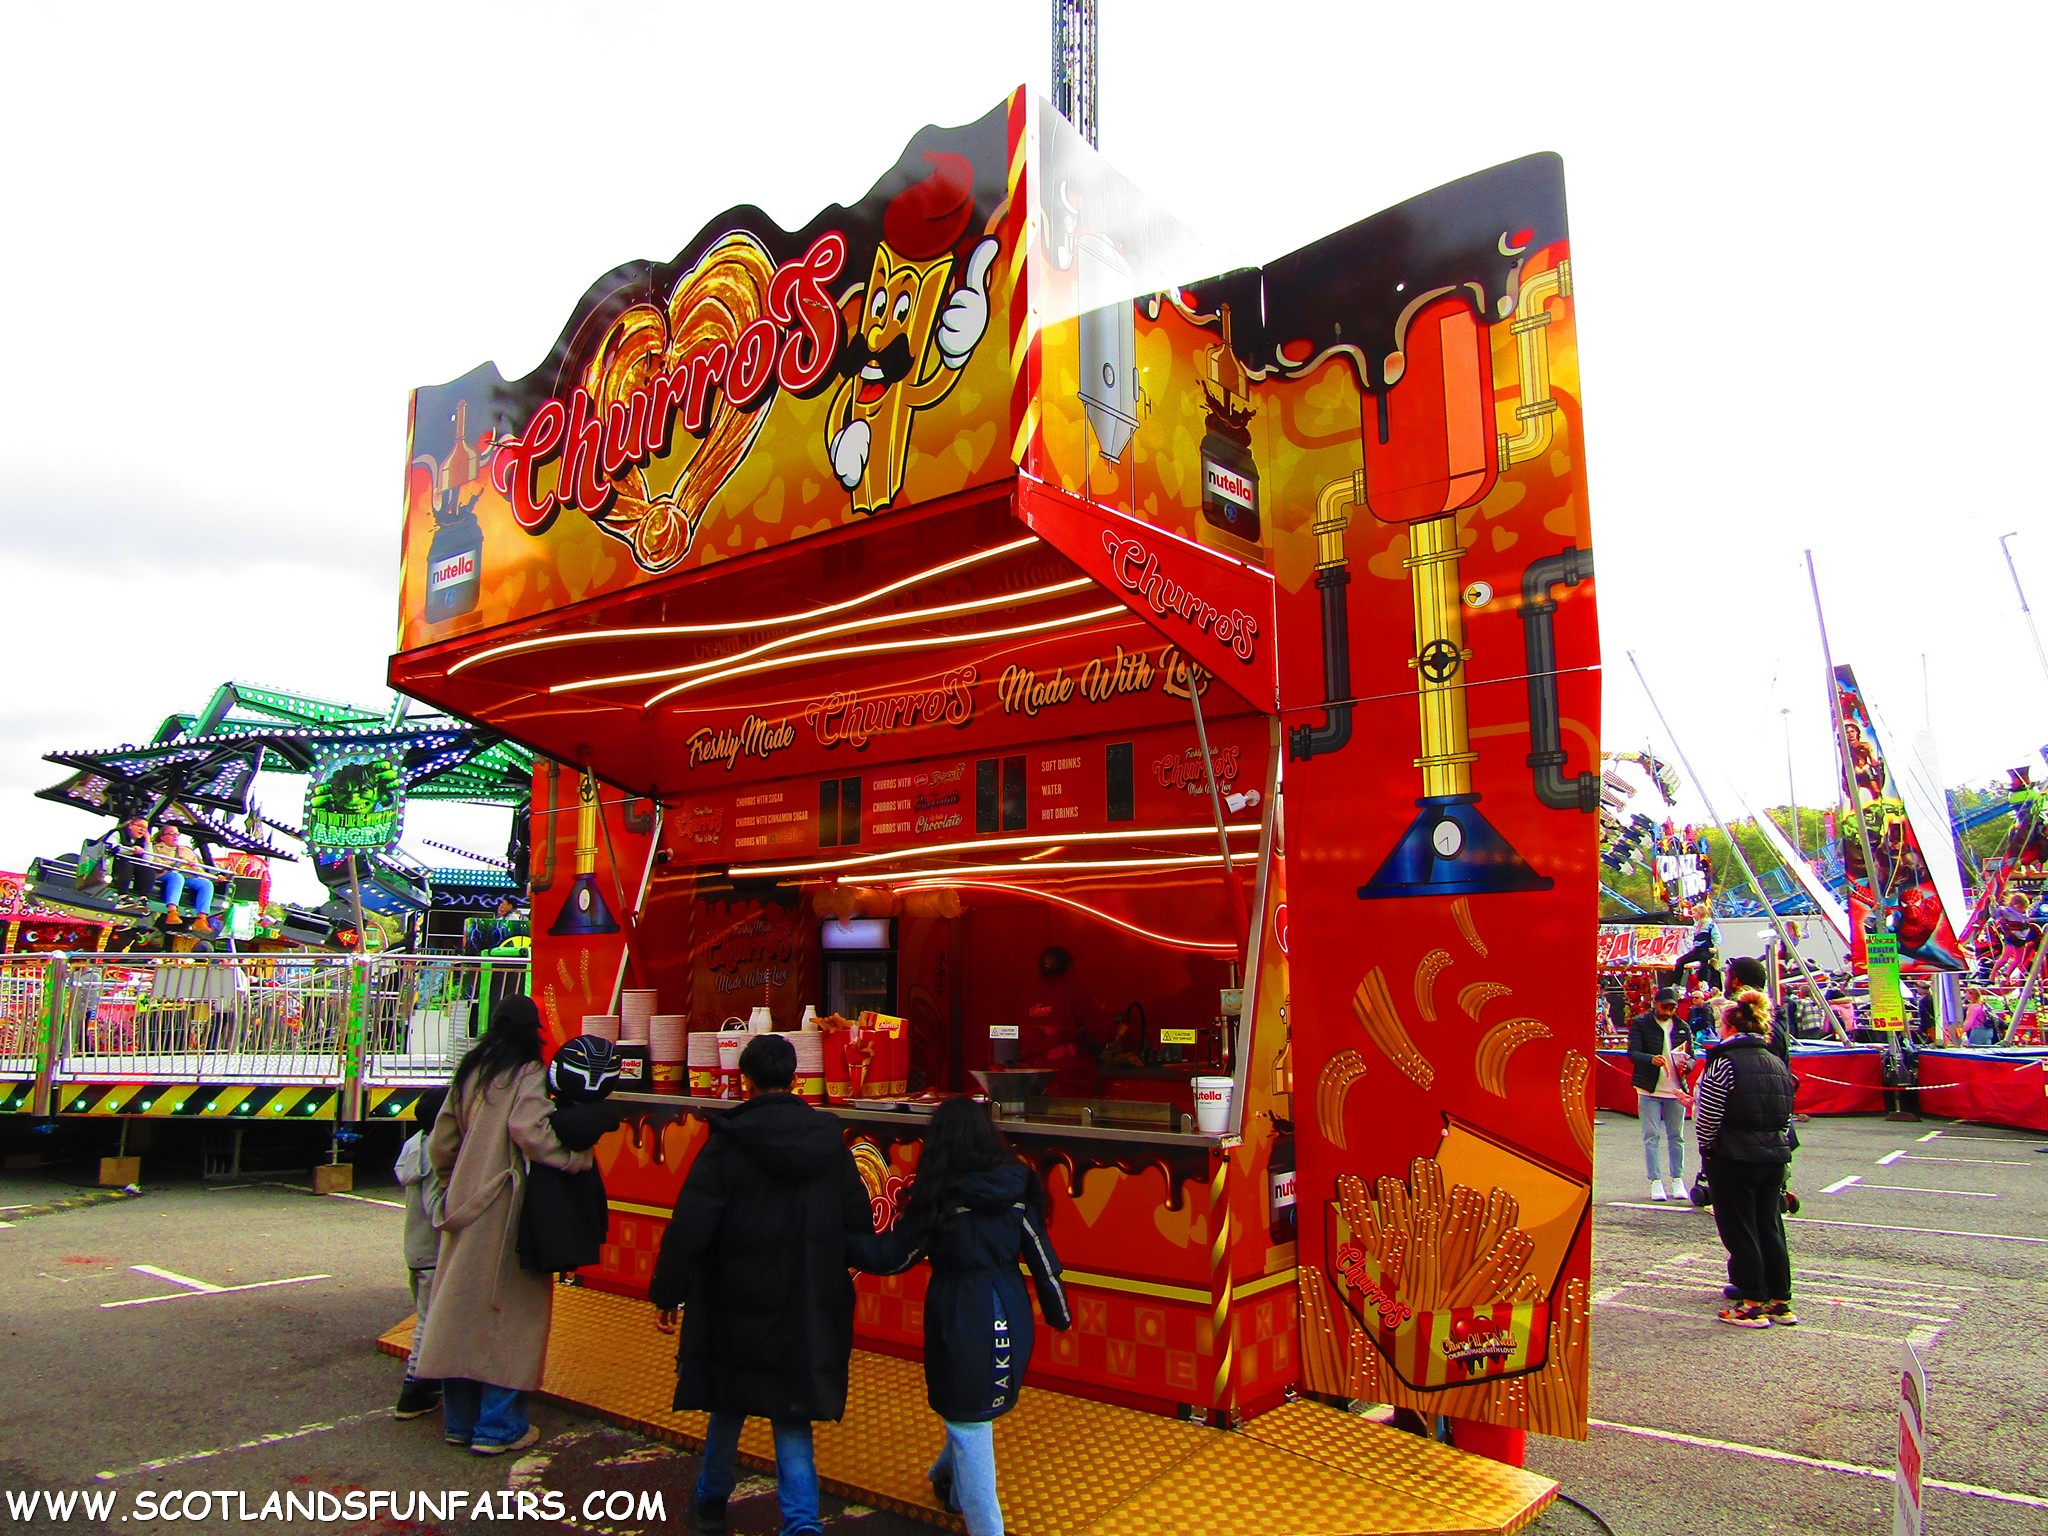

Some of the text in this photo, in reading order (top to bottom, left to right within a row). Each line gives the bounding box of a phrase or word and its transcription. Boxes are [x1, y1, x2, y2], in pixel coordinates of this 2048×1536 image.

[1208, 470, 1252, 502] nutella
[432, 556, 473, 585] nutella
[999, 664, 1075, 716] Made
[1081, 645, 1156, 703] With
[686, 714, 795, 770] Freshly Made
[1041, 757, 1082, 772] SOFT DRINKS
[1152, 746, 1240, 789] ChuroS
[873, 779, 897, 791] CHURROS
[897, 776, 911, 788] WITH
[1041, 783, 1062, 796] WATER
[736, 793, 784, 808] CHURROS WITH SUGAR
[873, 800, 897, 813] CHURROS
[897, 799, 911, 810] WITH
[736, 811, 809, 828] CHURROS WITH CINNAMON SUGAR
[872, 822, 896, 835] CHURROS
[896, 821, 911, 833] WITH
[915, 813, 963, 835] Chocolate
[1041, 806, 1079, 821] HOT DRINKS
[313, 822, 392, 846] ANGRY
[735, 836, 756, 848] CHURROS
[755, 835, 768, 845] WITH
[1607, 932, 1631, 961] A
[715, 972, 742, 994] Made
[770, 966, 788, 987] Love
[346, 1017, 363, 1078] HULK
[1467, 1333, 1482, 1347] All
[992, 1319, 1011, 1408] BAKER
